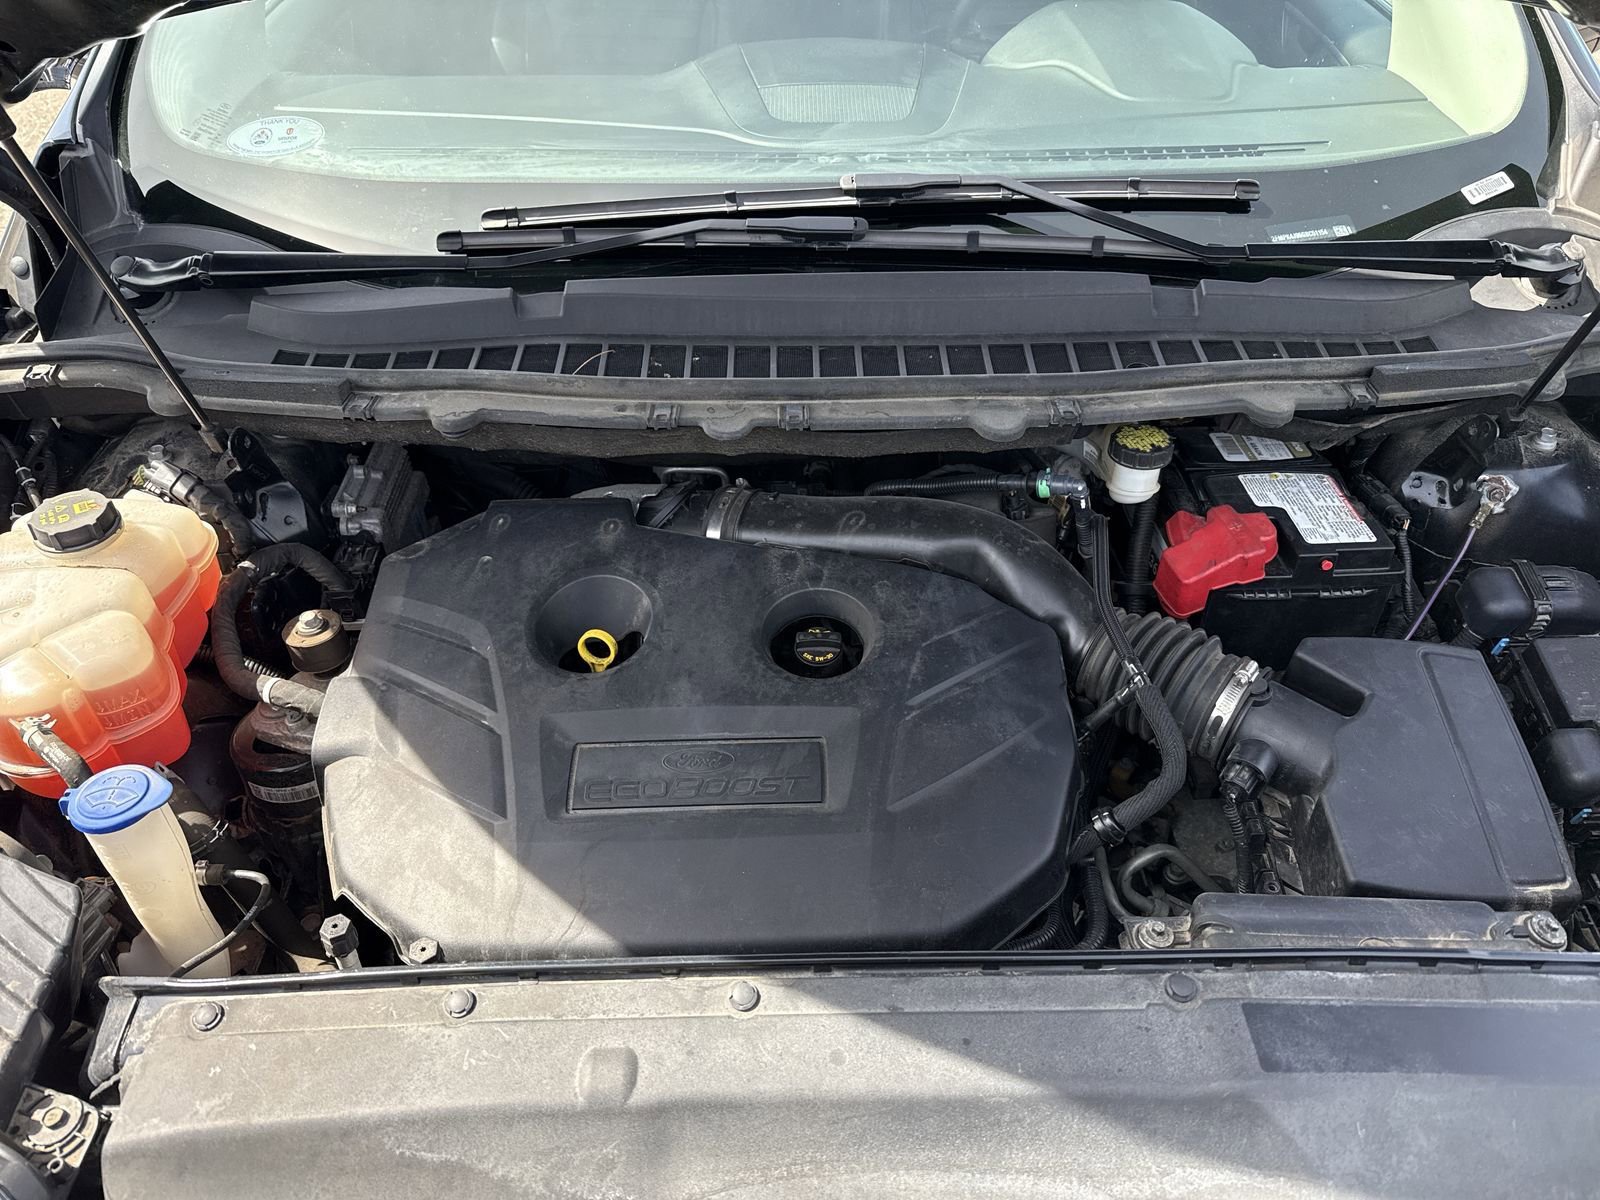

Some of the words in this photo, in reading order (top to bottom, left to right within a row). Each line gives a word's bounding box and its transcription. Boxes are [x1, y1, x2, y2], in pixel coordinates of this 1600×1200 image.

[285, 117, 301, 125] YOU
[103, 688, 144, 712] MAX
[676, 751, 724, 769] Ford
[583, 775, 811, 803] ECOBOOST
